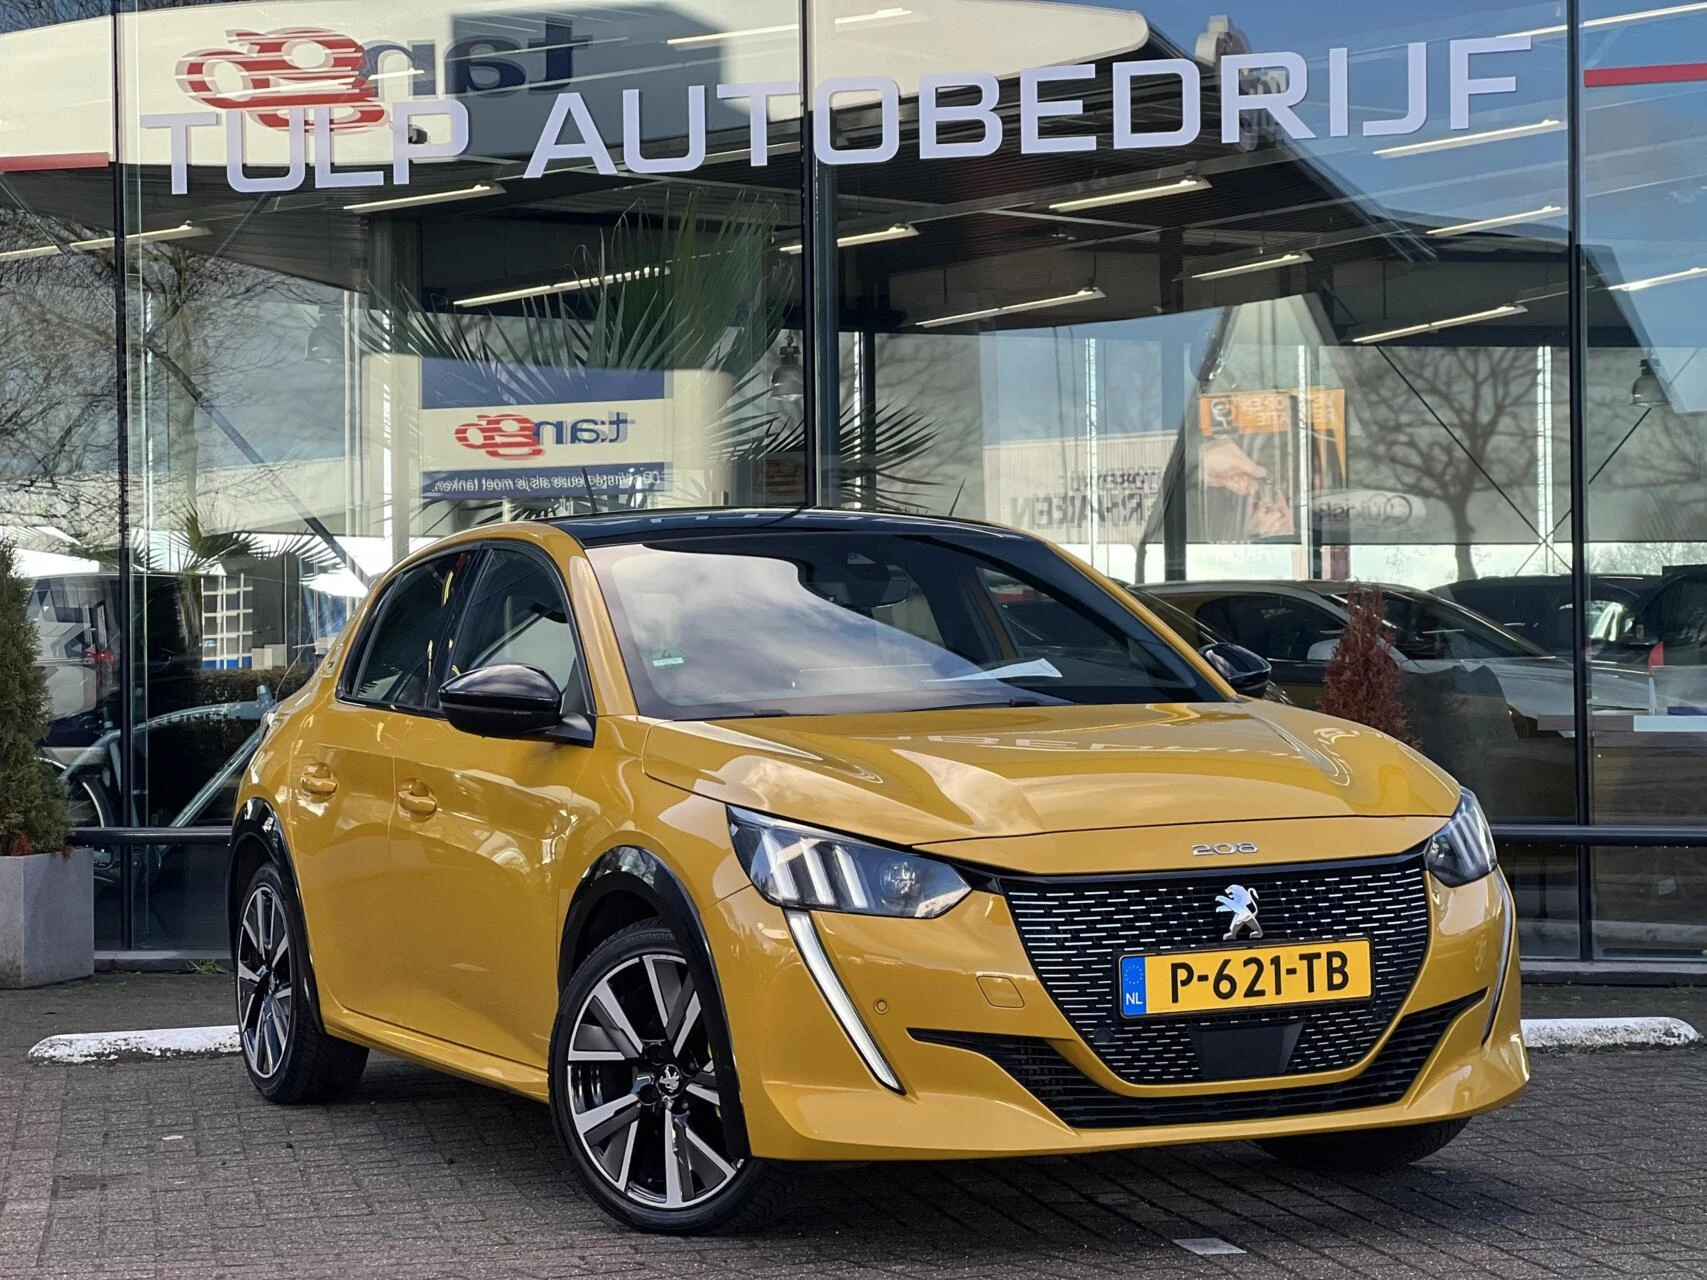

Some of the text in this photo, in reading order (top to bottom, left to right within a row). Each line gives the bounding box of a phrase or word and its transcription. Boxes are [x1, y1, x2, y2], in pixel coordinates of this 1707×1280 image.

[140, 36, 1532, 195] TULP AUTOBEDRIJF
[1192, 841, 1260, 857] 208
[1170, 950, 1350, 1004] P-621-TB
[1125, 992, 1144, 1006] NL
